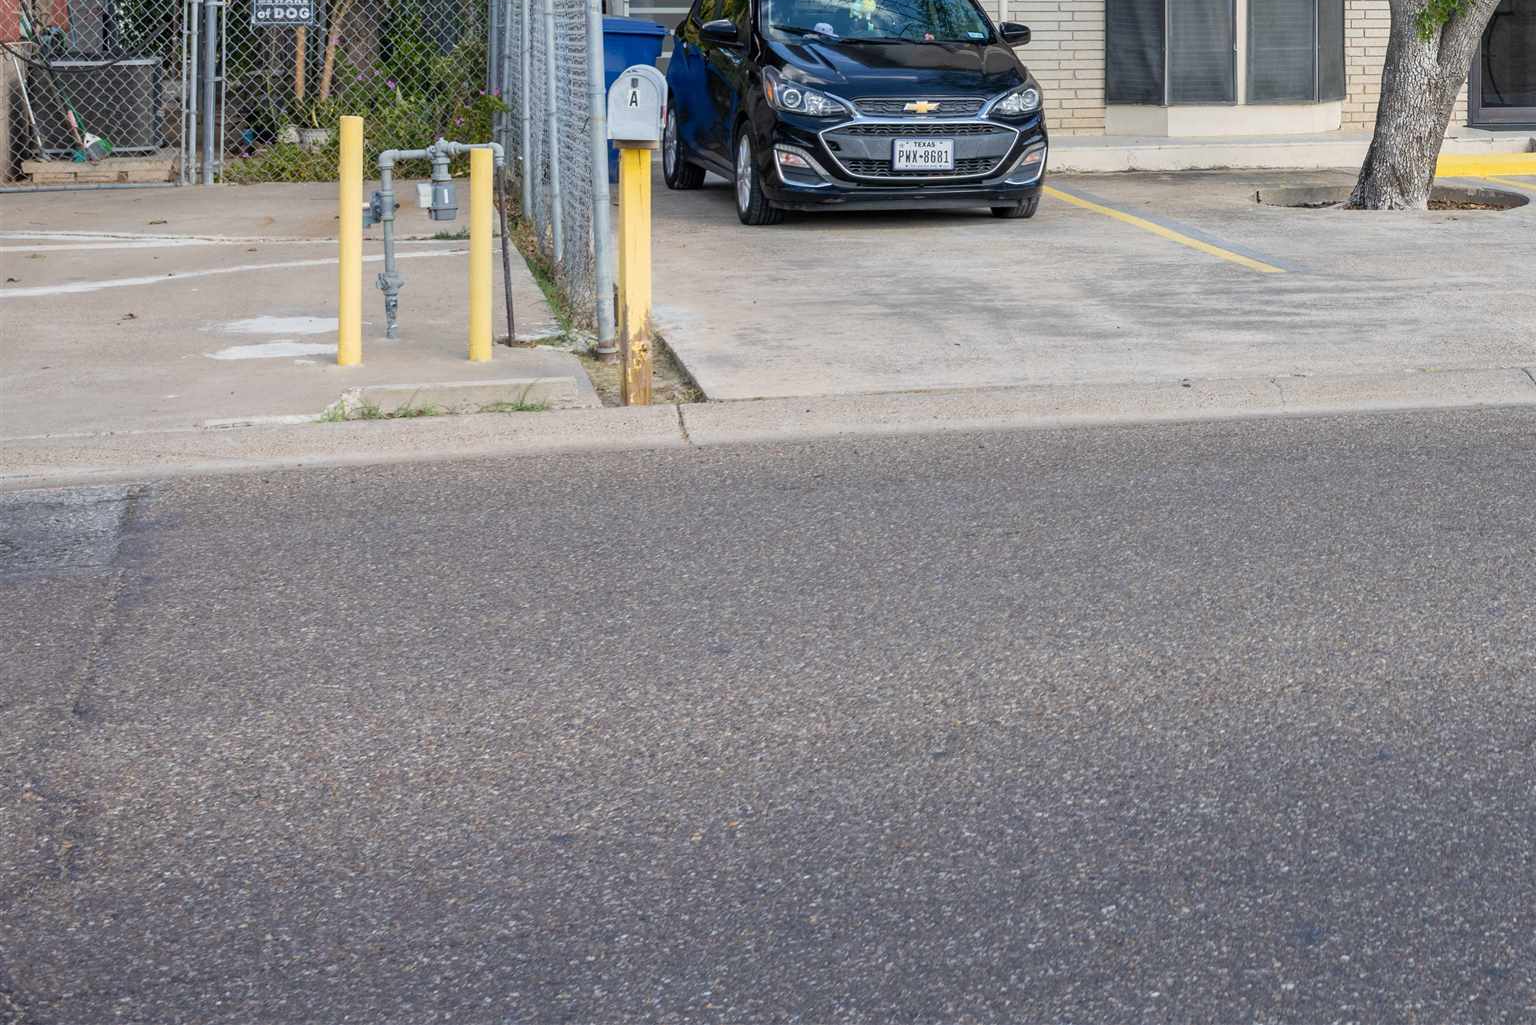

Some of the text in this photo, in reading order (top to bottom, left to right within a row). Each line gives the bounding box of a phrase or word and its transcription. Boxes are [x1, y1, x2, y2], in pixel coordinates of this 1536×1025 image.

[257, 7, 310, 19] of DOG
[629, 90, 638, 107] A
